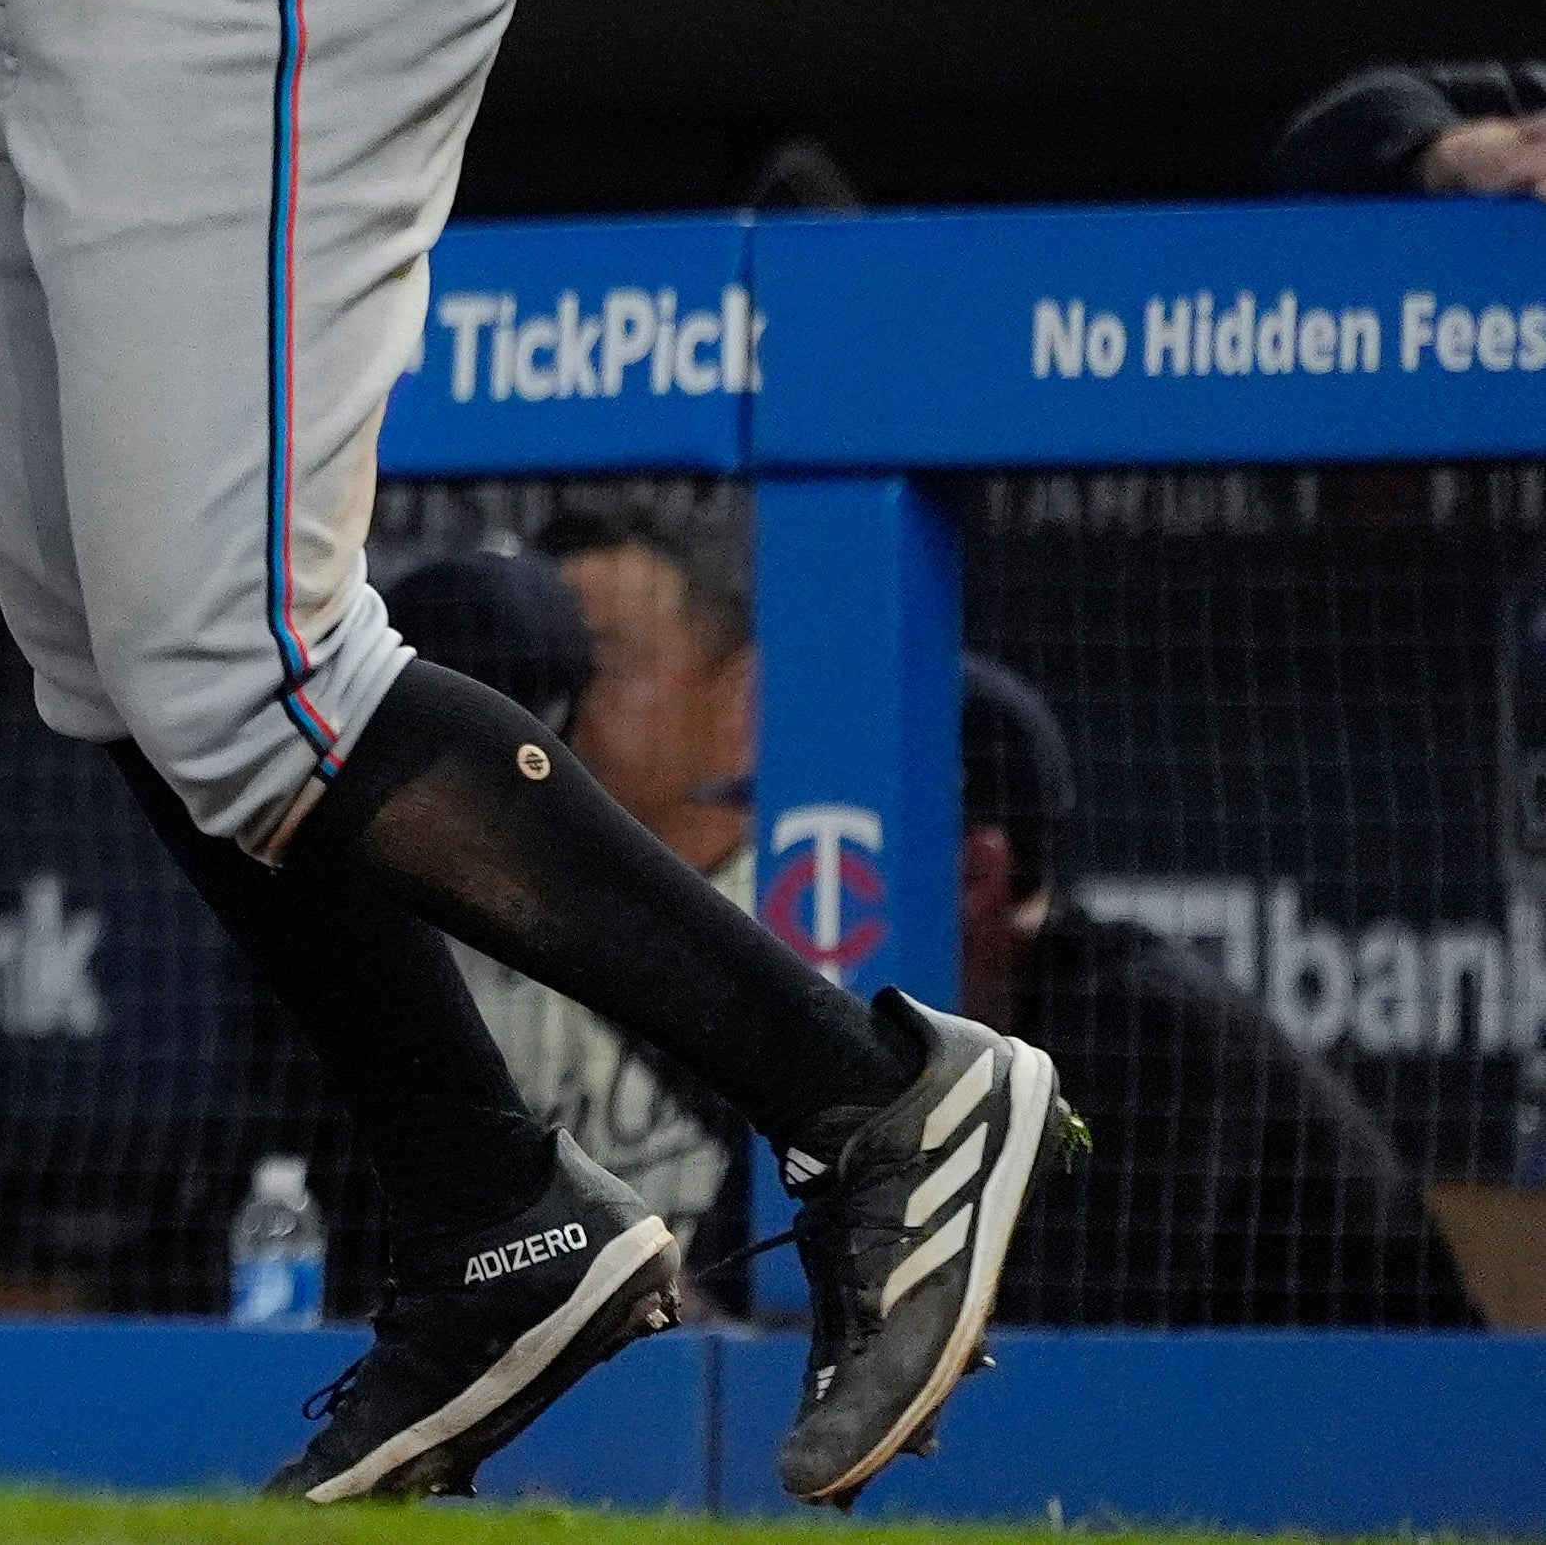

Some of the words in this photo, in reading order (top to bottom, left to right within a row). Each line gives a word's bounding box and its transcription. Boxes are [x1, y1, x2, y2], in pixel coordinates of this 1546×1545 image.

[438, 285, 769, 402] TickPick
[1031, 296, 1127, 379] No
[1142, 289, 1381, 377] Hidden
[1400, 290, 1546, 375] Fees
[464, 1222, 588, 1285] ADIZERO
